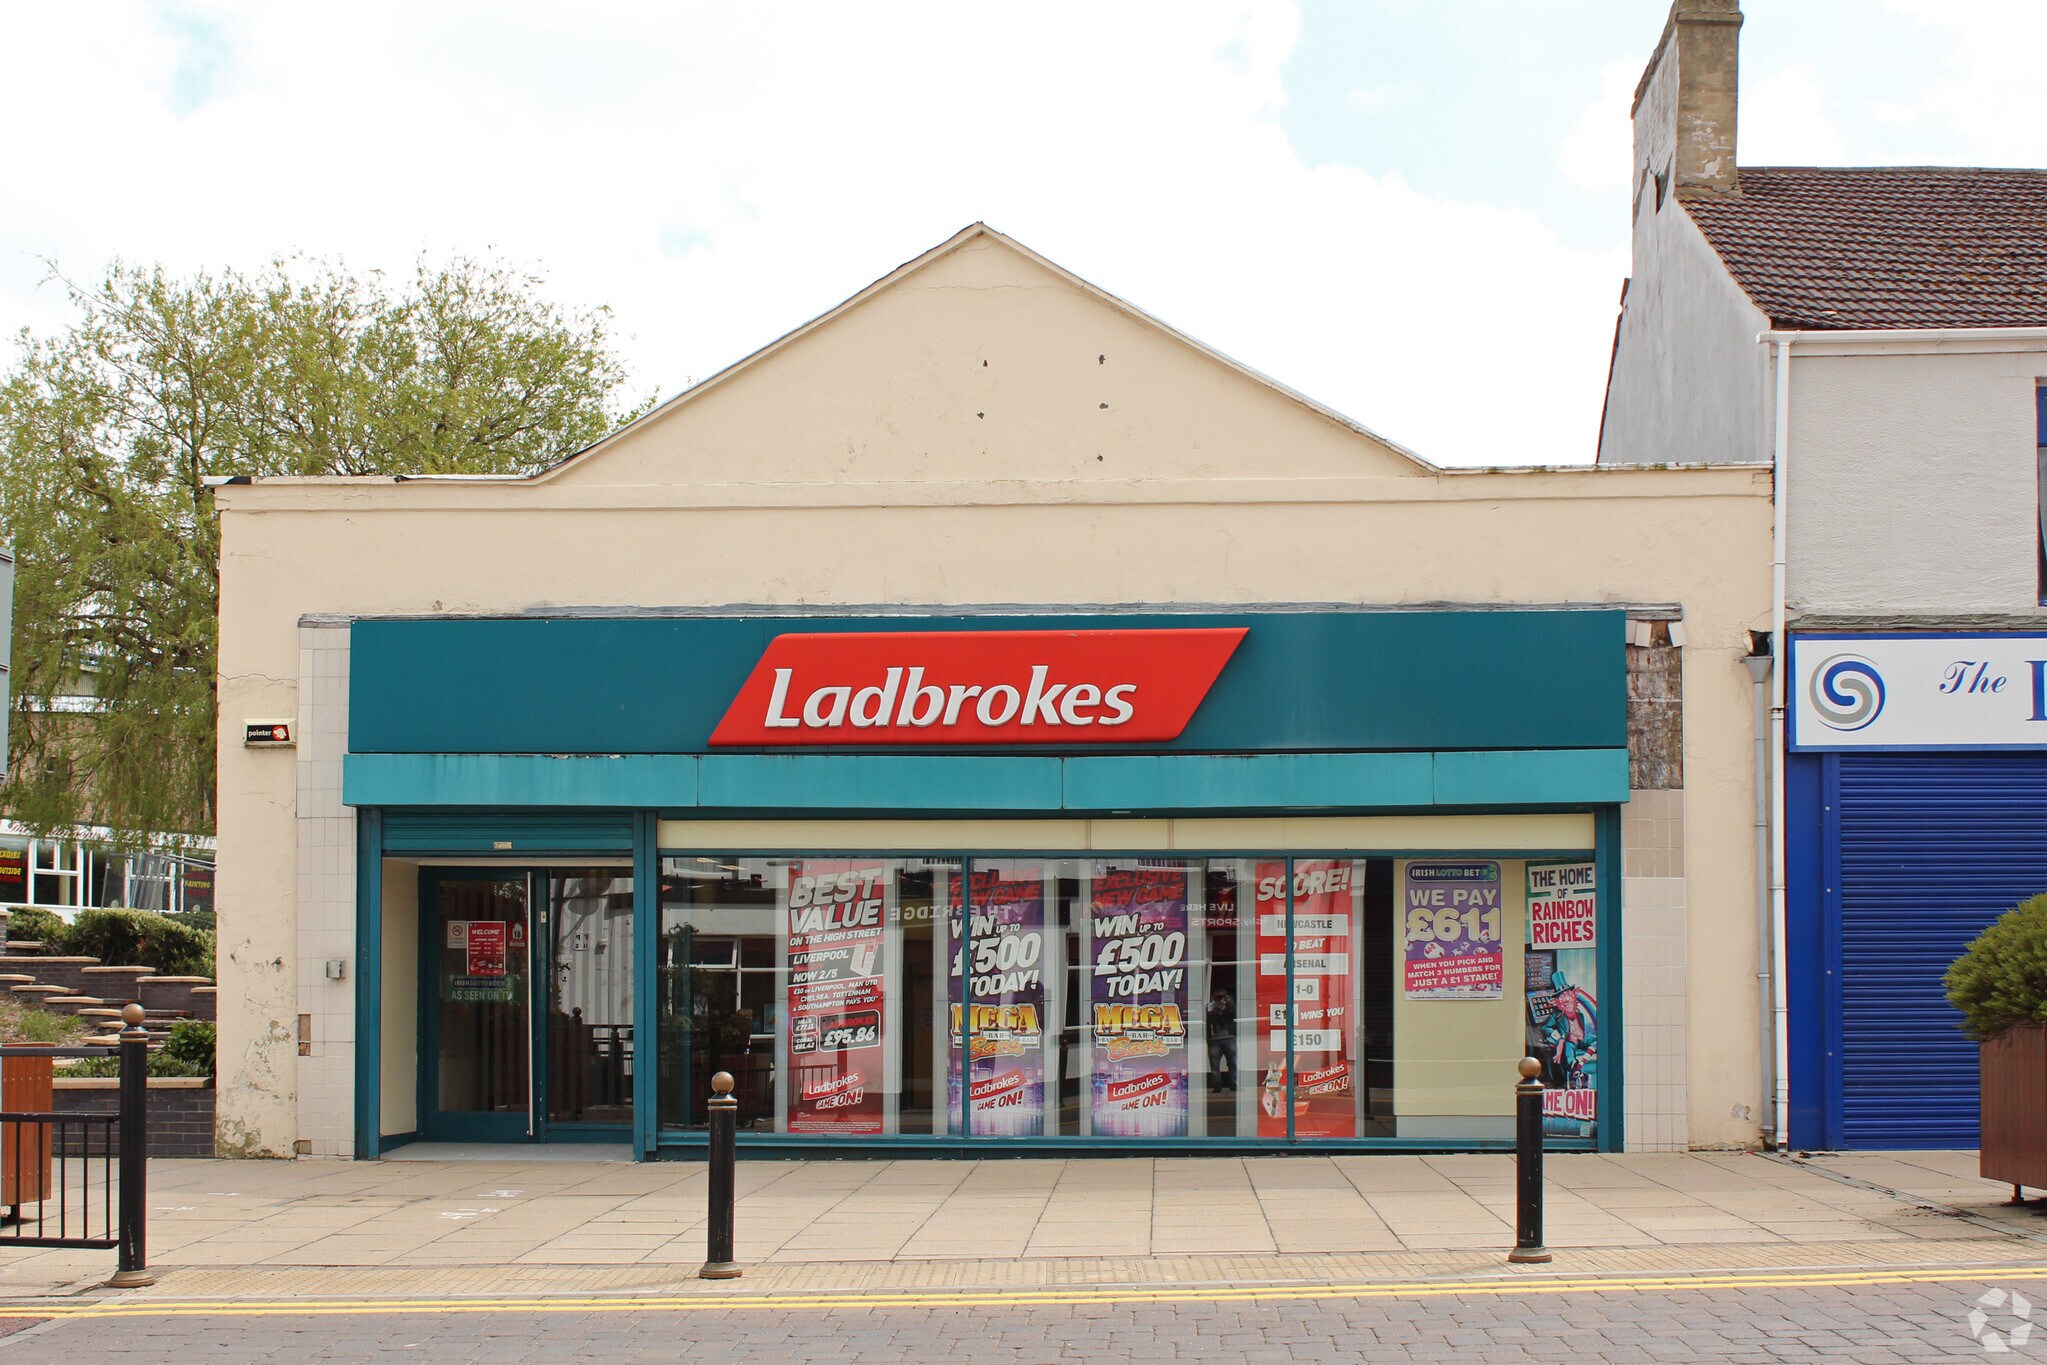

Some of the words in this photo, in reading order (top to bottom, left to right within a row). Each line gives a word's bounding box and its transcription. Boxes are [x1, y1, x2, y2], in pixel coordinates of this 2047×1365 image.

[1939, 660, 2007, 694] The
[764, 665, 1138, 727] Ladbrokes
[248, 730, 272, 738] pointer
[1093, 870, 1183, 891] EXCLUSIVE
[1411, 869, 1435, 877] IRISH
[1435, 868, 1463, 877] LOTTO
[1532, 870, 1557, 888] THE
[1558, 867, 1593, 886] HOME
[789, 868, 882, 908] BEST
[992, 884, 1041, 905] GAME
[1257, 867, 1350, 901] SCORE!
[1557, 888, 1568, 899] OF
[1095, 889, 1135, 907] NEW
[1136, 883, 1185, 905] GAME
[1409, 889, 1445, 906] WE
[1453, 888, 1497, 906] PAY
[790, 899, 882, 934] VALUE
[1532, 899, 1593, 921] RAINBOW
[514, 930, 521, 938] 18
[952, 915, 995, 939] WIN
[995, 924, 1007, 934] UP
[1009, 923, 1020, 932] TO
[1094, 914, 1139, 938] WIN
[1139, 924, 1151, 933] UP
[1153, 922, 1164, 931] TO
[1277, 919, 1333, 929] NWCASTLE
[1406, 907, 1501, 942] £611
[1533, 920, 1594, 944] RICHES
[789, 936, 804, 946] ON
[805, 934, 824, 944] THE
[824, 931, 845, 943] HIGH
[846, 928, 883, 939] STREET
[1299, 938, 1326, 950] BEAT
[793, 949, 849, 965] LIVERPOOL
[951, 932, 1042, 977] £500
[1094, 931, 1185, 976] £500
[1283, 959, 1327, 968] SENAL
[1413, 962, 1437, 970] WHEN
[1438, 960, 1455, 968] YOU
[1457, 958, 1476, 966] PICK
[1477, 956, 1494, 964] AND
[793, 971, 817, 983] NOW
[819, 968, 838, 979] 2/5
[1408, 970, 1435, 979] MATCH
[1443, 966, 1483, 976] NUMBERS
[1485, 964, 1501, 972] FOR
[1412, 977, 1439, 988] JUST
[1441, 977, 1448, 985] A
[1450, 975, 1460, 984] £1
[832, 988, 872, 998] TOTTENHAM
[848, 981, 863, 989] MAN
[865, 979, 878, 987] UTD
[969, 969, 1040, 997] TODAY!
[1107, 969, 1184, 997] TODAY!
[1295, 984, 1314, 995] 1-0
[451, 990, 462, 1000] AS
[464, 990, 484, 1000] SEEN
[487, 991, 499, 1000] ON
[797, 1000, 845, 1011] SOUTHAMPTON
[845, 997, 861, 1006] PAYS
[822, 1015, 876, 1030] LADBROKES
[952, 1004, 1040, 1035] MEGA
[1095, 1004, 1184, 1035] MEGA
[1300, 1010, 1324, 1020] WINS
[1327, 1007, 1344, 1017] YOU
[823, 1025, 876, 1047] £95.86
[1293, 1033, 1322, 1046] £150
[808, 1072, 859, 1095] Ladbrokes
[1302, 1063, 1345, 1083] Ladbrokes
[970, 1074, 1020, 1097] Ladbrokes
[1112, 1074, 1164, 1097] Ladbrokes
[837, 1087, 863, 1107] ON!
[977, 1099, 997, 1110] GAME
[997, 1090, 1024, 1107] ON!
[1120, 1099, 1141, 1111] GAME
[1142, 1090, 1167, 1108] ON!
[1543, 1091, 1563, 1112] ME
[1565, 1090, 1593, 1116] ON!
